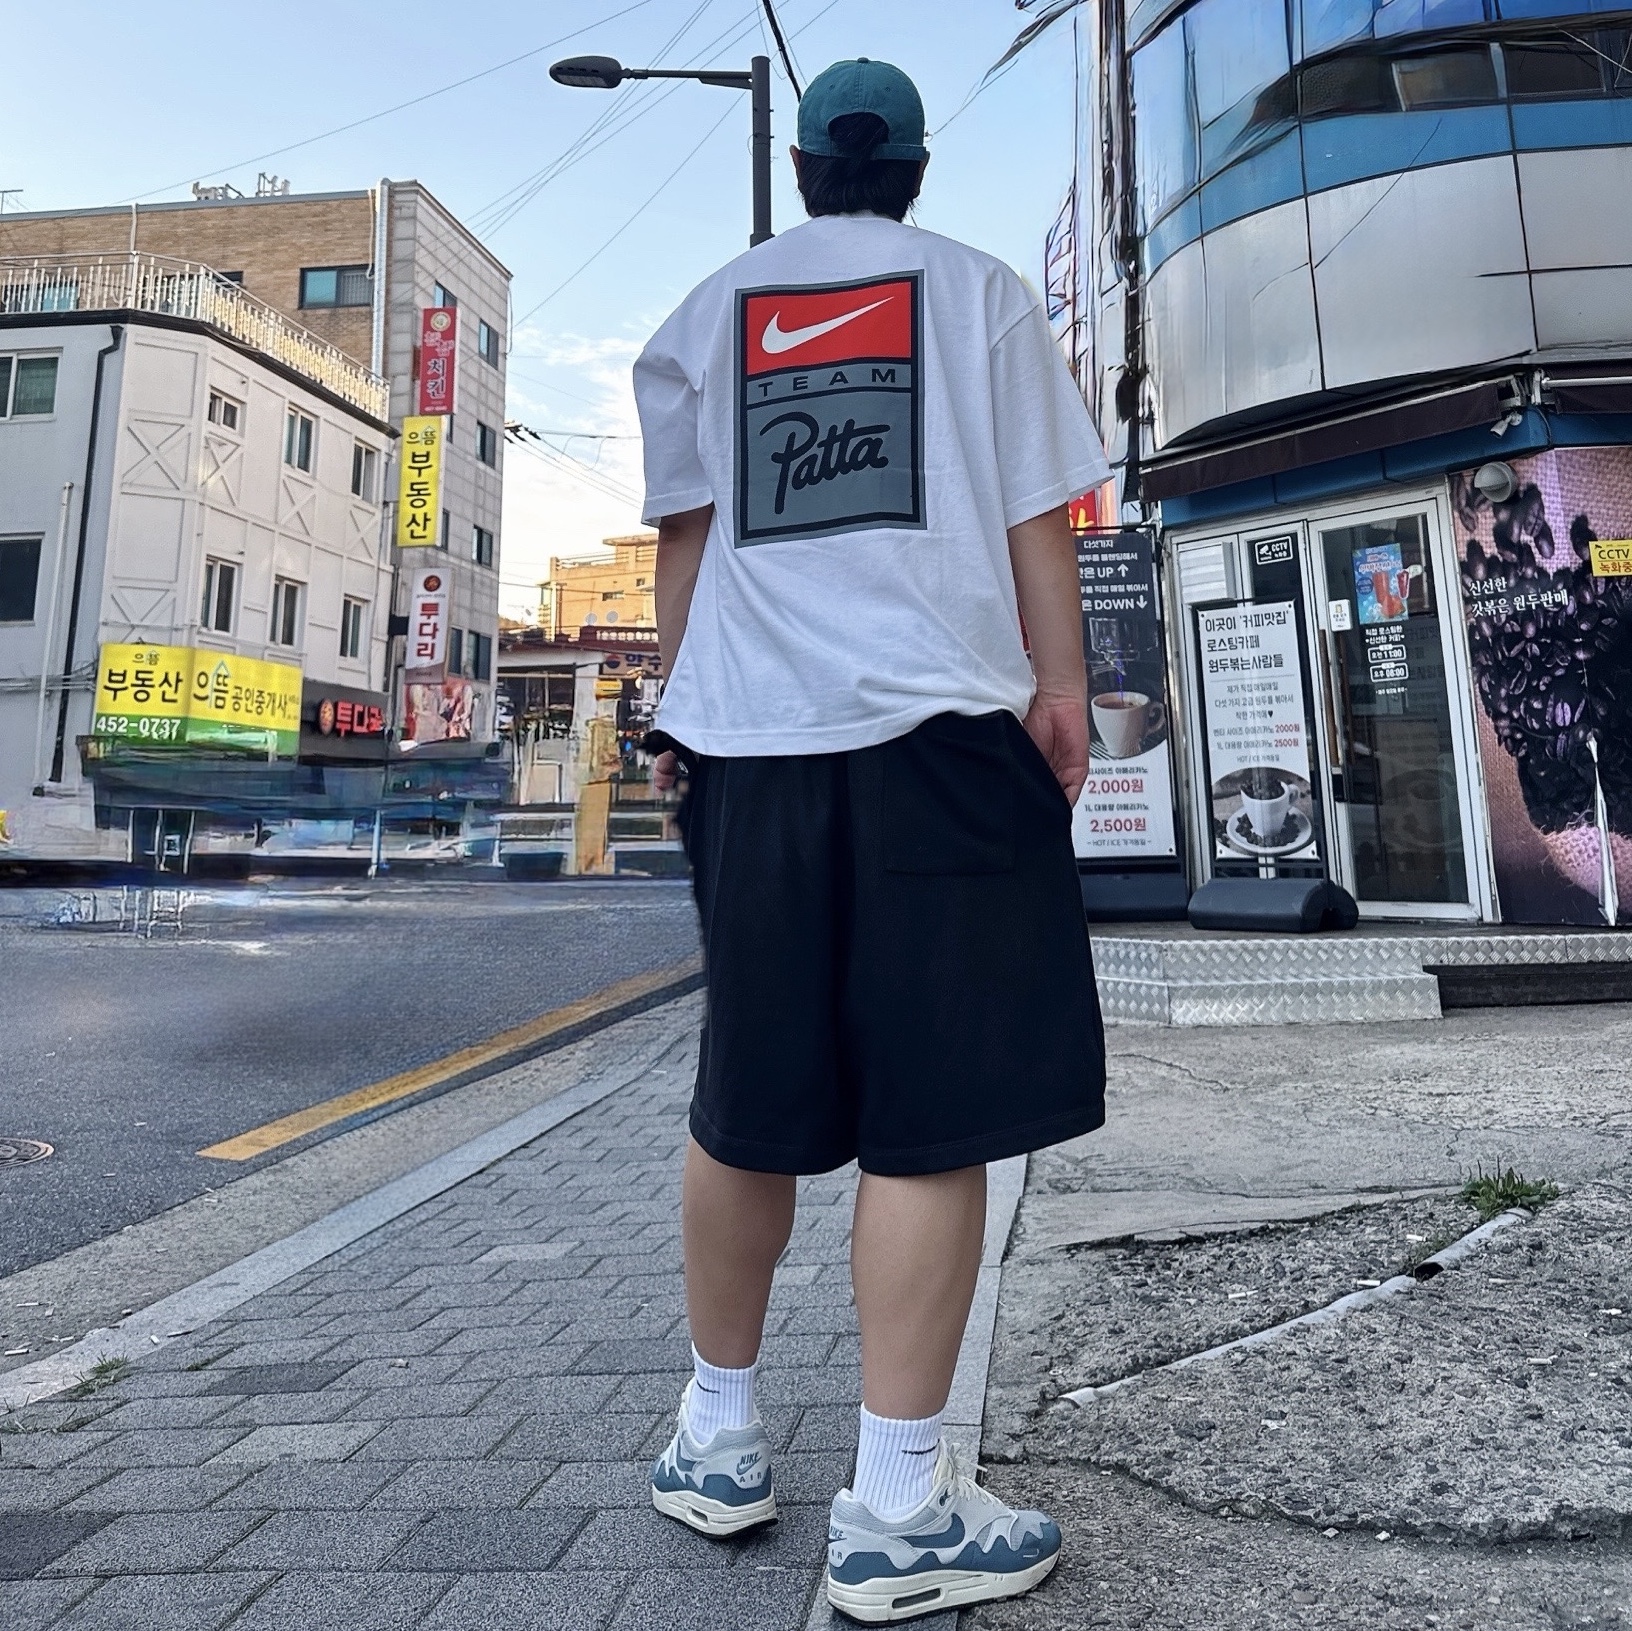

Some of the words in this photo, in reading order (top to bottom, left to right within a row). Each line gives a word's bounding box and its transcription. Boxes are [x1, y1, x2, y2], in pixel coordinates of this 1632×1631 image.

[758, 368, 896, 397] TEAM
[759, 411, 891, 514] Patta
[405, 450, 434, 540] 부동산
[1271, 541, 1288, 552] CCTV
[1598, 548, 1630, 560] CCTV
[1079, 567, 1095, 578] 은
[1097, 566, 1114, 578] UP
[1600, 561, 1632, 573] 녹화중
[1469, 576, 1508, 596] 신선한
[1094, 598, 1135, 610] DOWN
[1471, 597, 1510, 618] 갓볶은
[1513, 589, 1569, 612] 원두판매
[416, 602, 439, 660] 투다리
[1205, 616, 1237, 632] 이곳이
[1207, 634, 1260, 652] 로스팅카페
[1384, 649, 1402, 659] 11:00
[1208, 654, 1284, 673] 원두볶는사람들
[103, 668, 183, 703] 부동산
[193, 671, 229, 710] 으뜸
[231, 685, 288, 718] 공인중개사
[1087, 778, 1144, 795] 2,000원
[1090, 817, 1147, 833] 2,500원
[740, 1451, 760, 1466] NIKE
[740, 1471, 762, 1483] AIR
